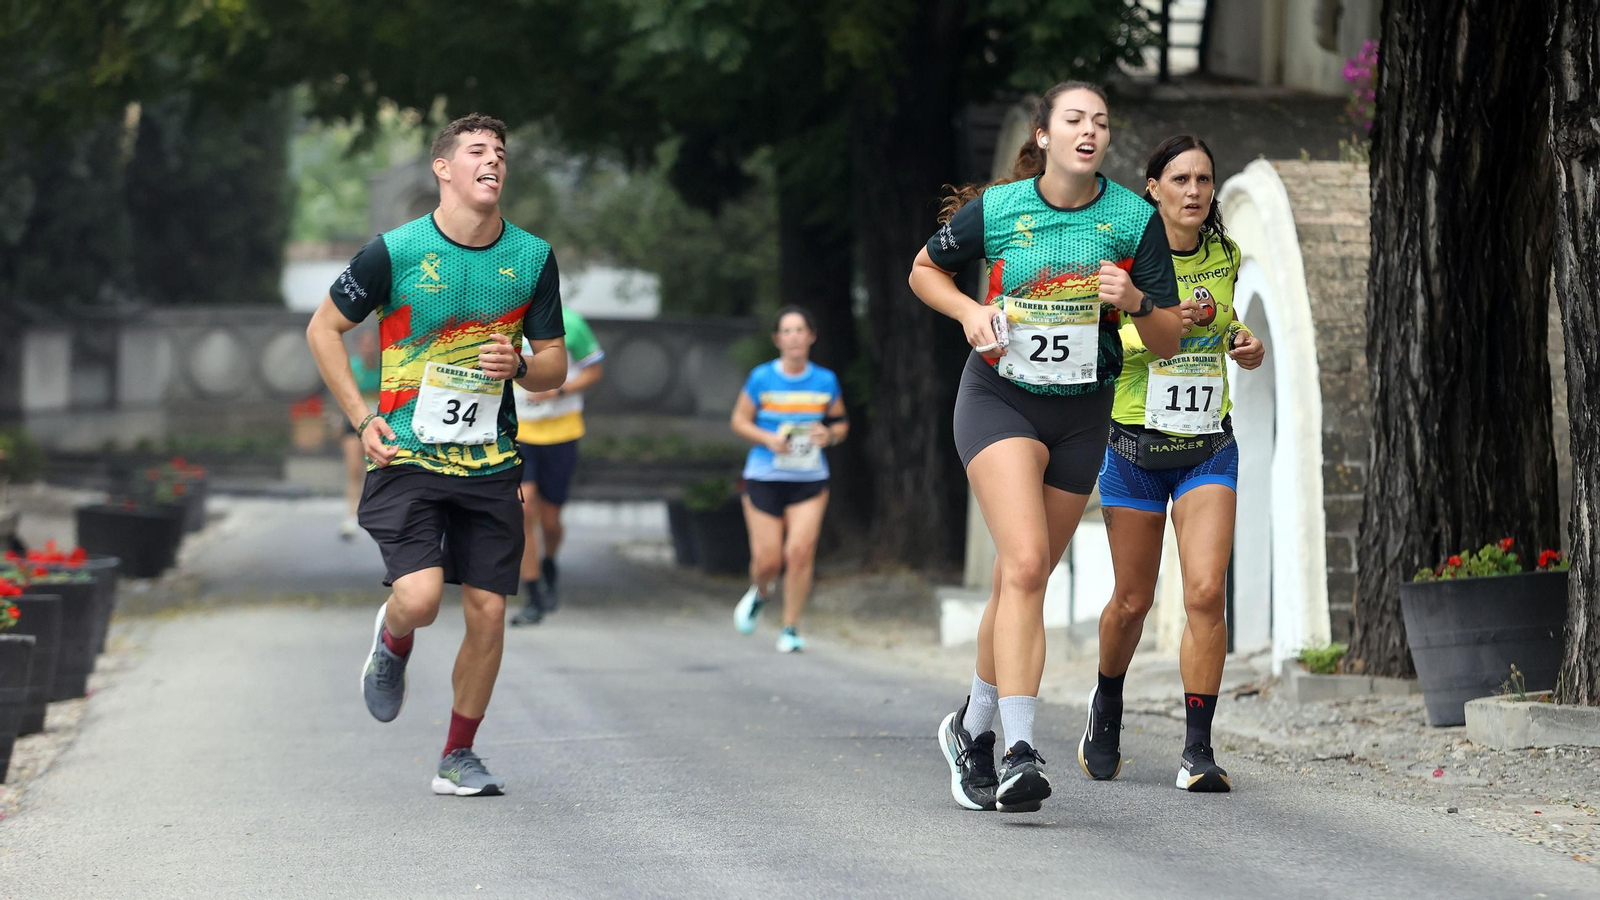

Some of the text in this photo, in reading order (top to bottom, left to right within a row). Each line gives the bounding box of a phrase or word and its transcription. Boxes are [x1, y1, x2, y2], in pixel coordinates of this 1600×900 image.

[1014, 301, 1093, 312] CARRERA SOLIDARIA
[1029, 334, 1070, 363] 25
[1158, 356, 1191, 368] CARRERA
[436, 366, 468, 378] CARRERA
[1165, 385, 1214, 412] 117
[442, 399, 479, 428] 34
[1149, 440, 1204, 453] HANKER
